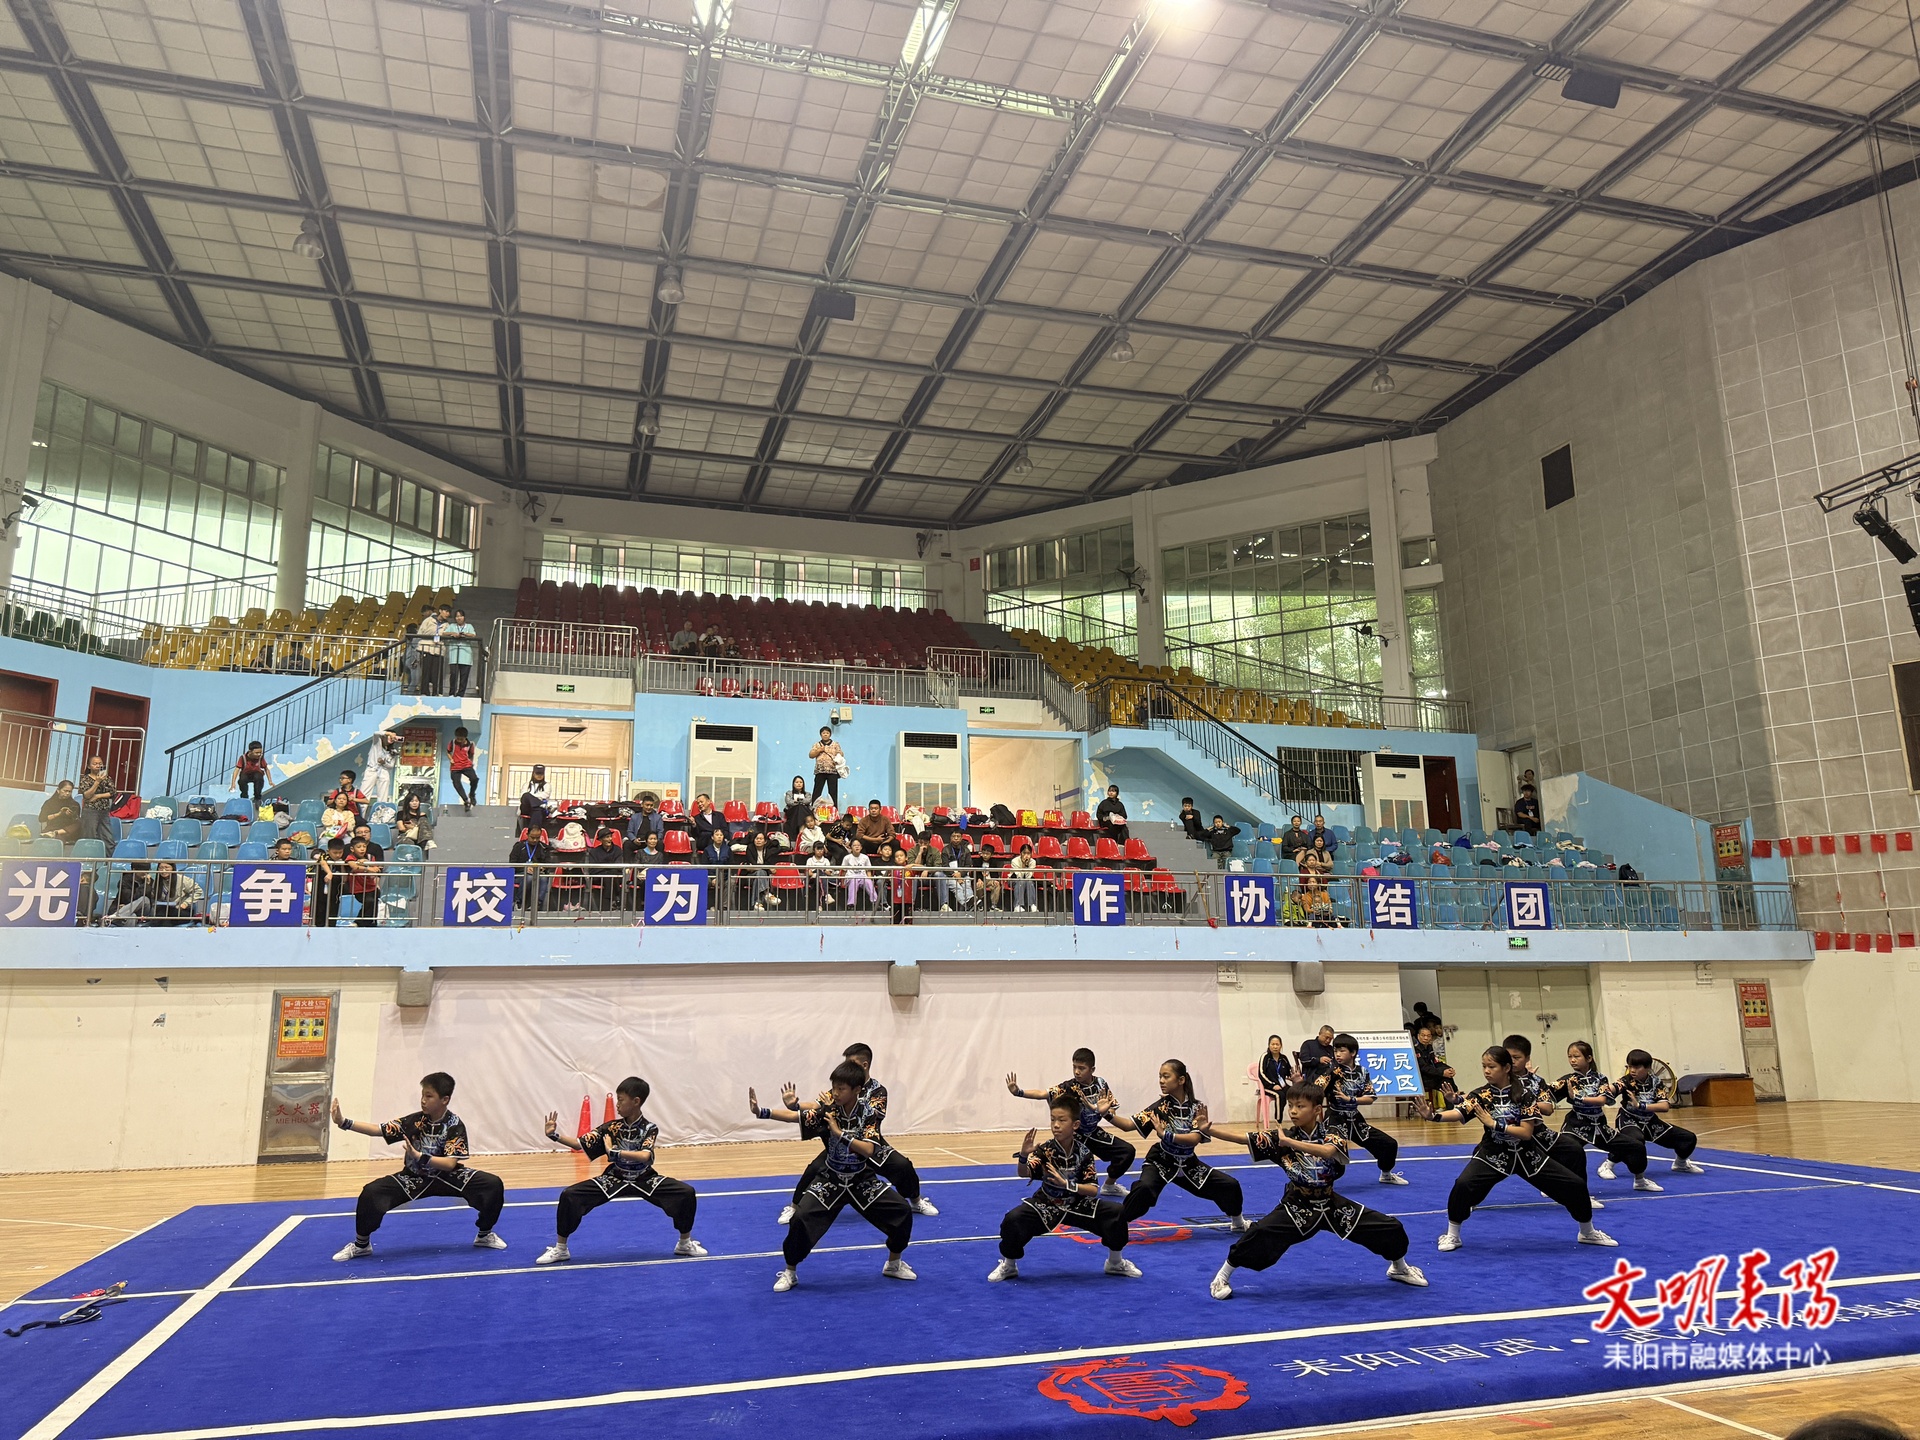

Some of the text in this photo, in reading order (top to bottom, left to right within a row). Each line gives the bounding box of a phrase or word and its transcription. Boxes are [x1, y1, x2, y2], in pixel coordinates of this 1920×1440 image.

[4, 866, 70, 922] 光
[239, 869, 297, 922] 争
[451, 870, 508, 923] 校
[650, 872, 701, 923] 为
[1079, 877, 1119, 923] 作
[1230, 879, 1270, 923] 协
[1374, 883, 1412, 926] 结
[1512, 888, 1545, 926] 团
[275, 1102, 321, 1115] 灭火器
